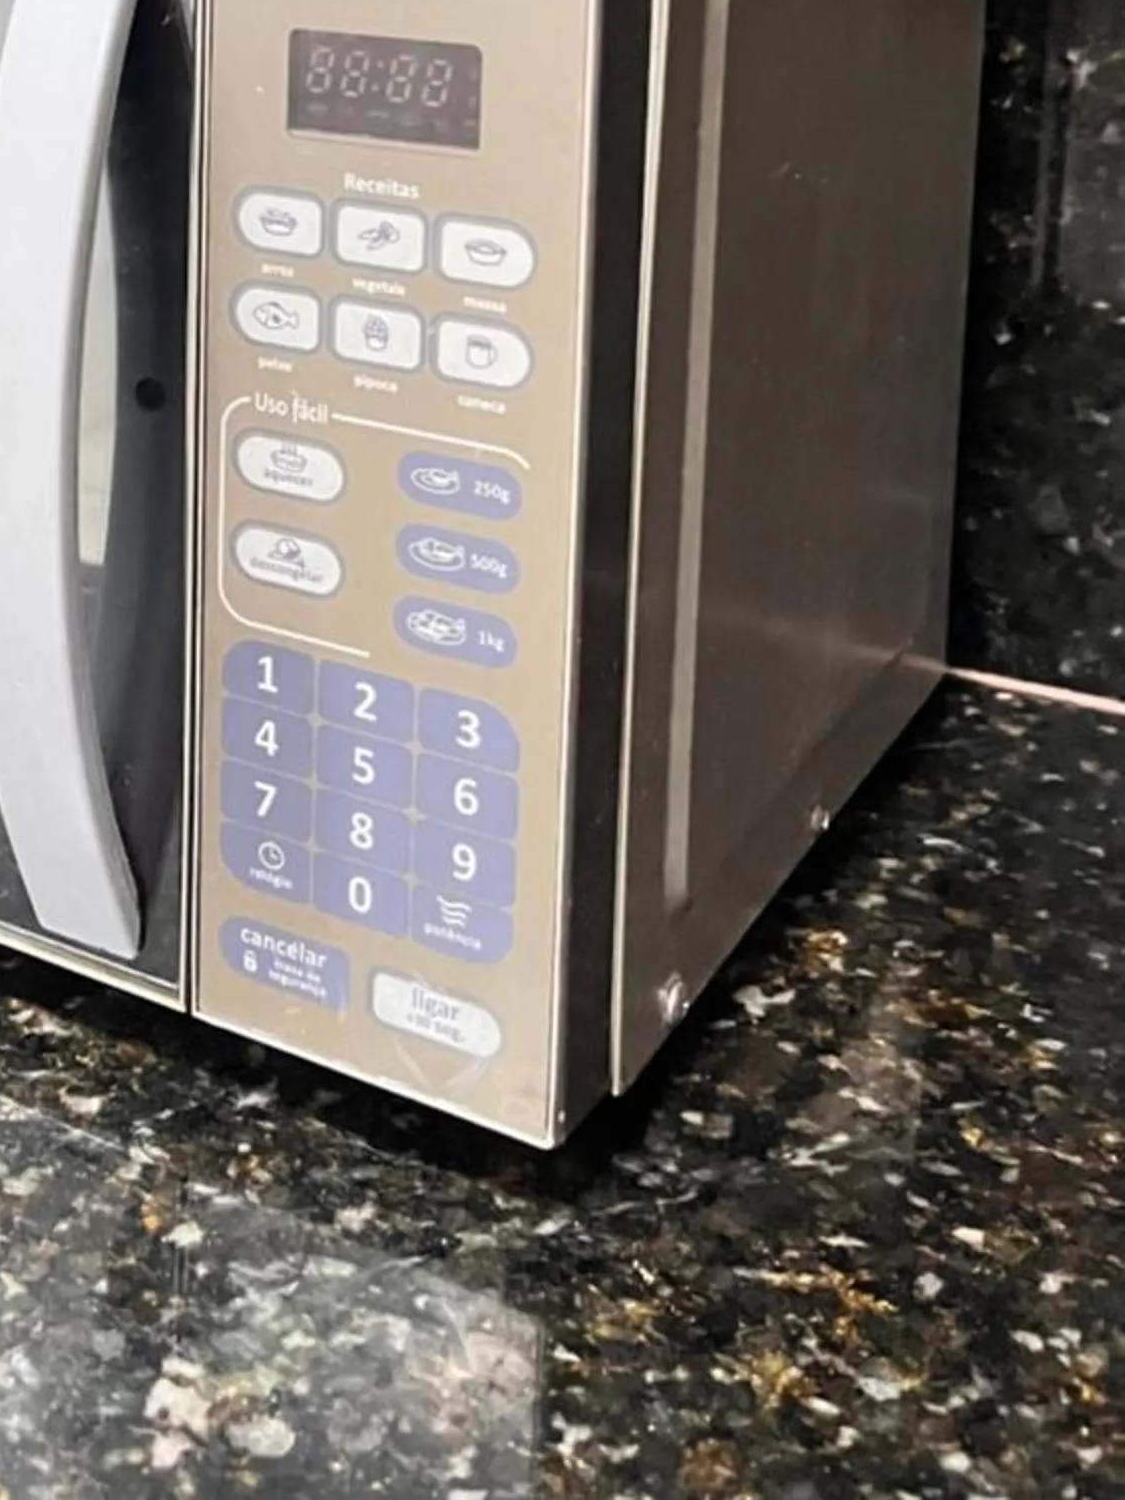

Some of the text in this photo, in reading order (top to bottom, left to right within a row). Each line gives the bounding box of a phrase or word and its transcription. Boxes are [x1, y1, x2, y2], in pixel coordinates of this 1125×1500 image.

[344, 172, 420, 199] Receitas
[255, 392, 328, 425] Uso fácil
[474, 480, 511, 506] 250g
[471, 554, 508, 580] 500g
[257, 656, 482, 749] 1 2 3
[254, 720, 479, 816] 4 5 6
[253, 780, 477, 882] 7 8 9
[348, 876, 373, 914] 0
[240, 927, 327, 969] cancelar
[411, 986, 461, 1021] ligar
